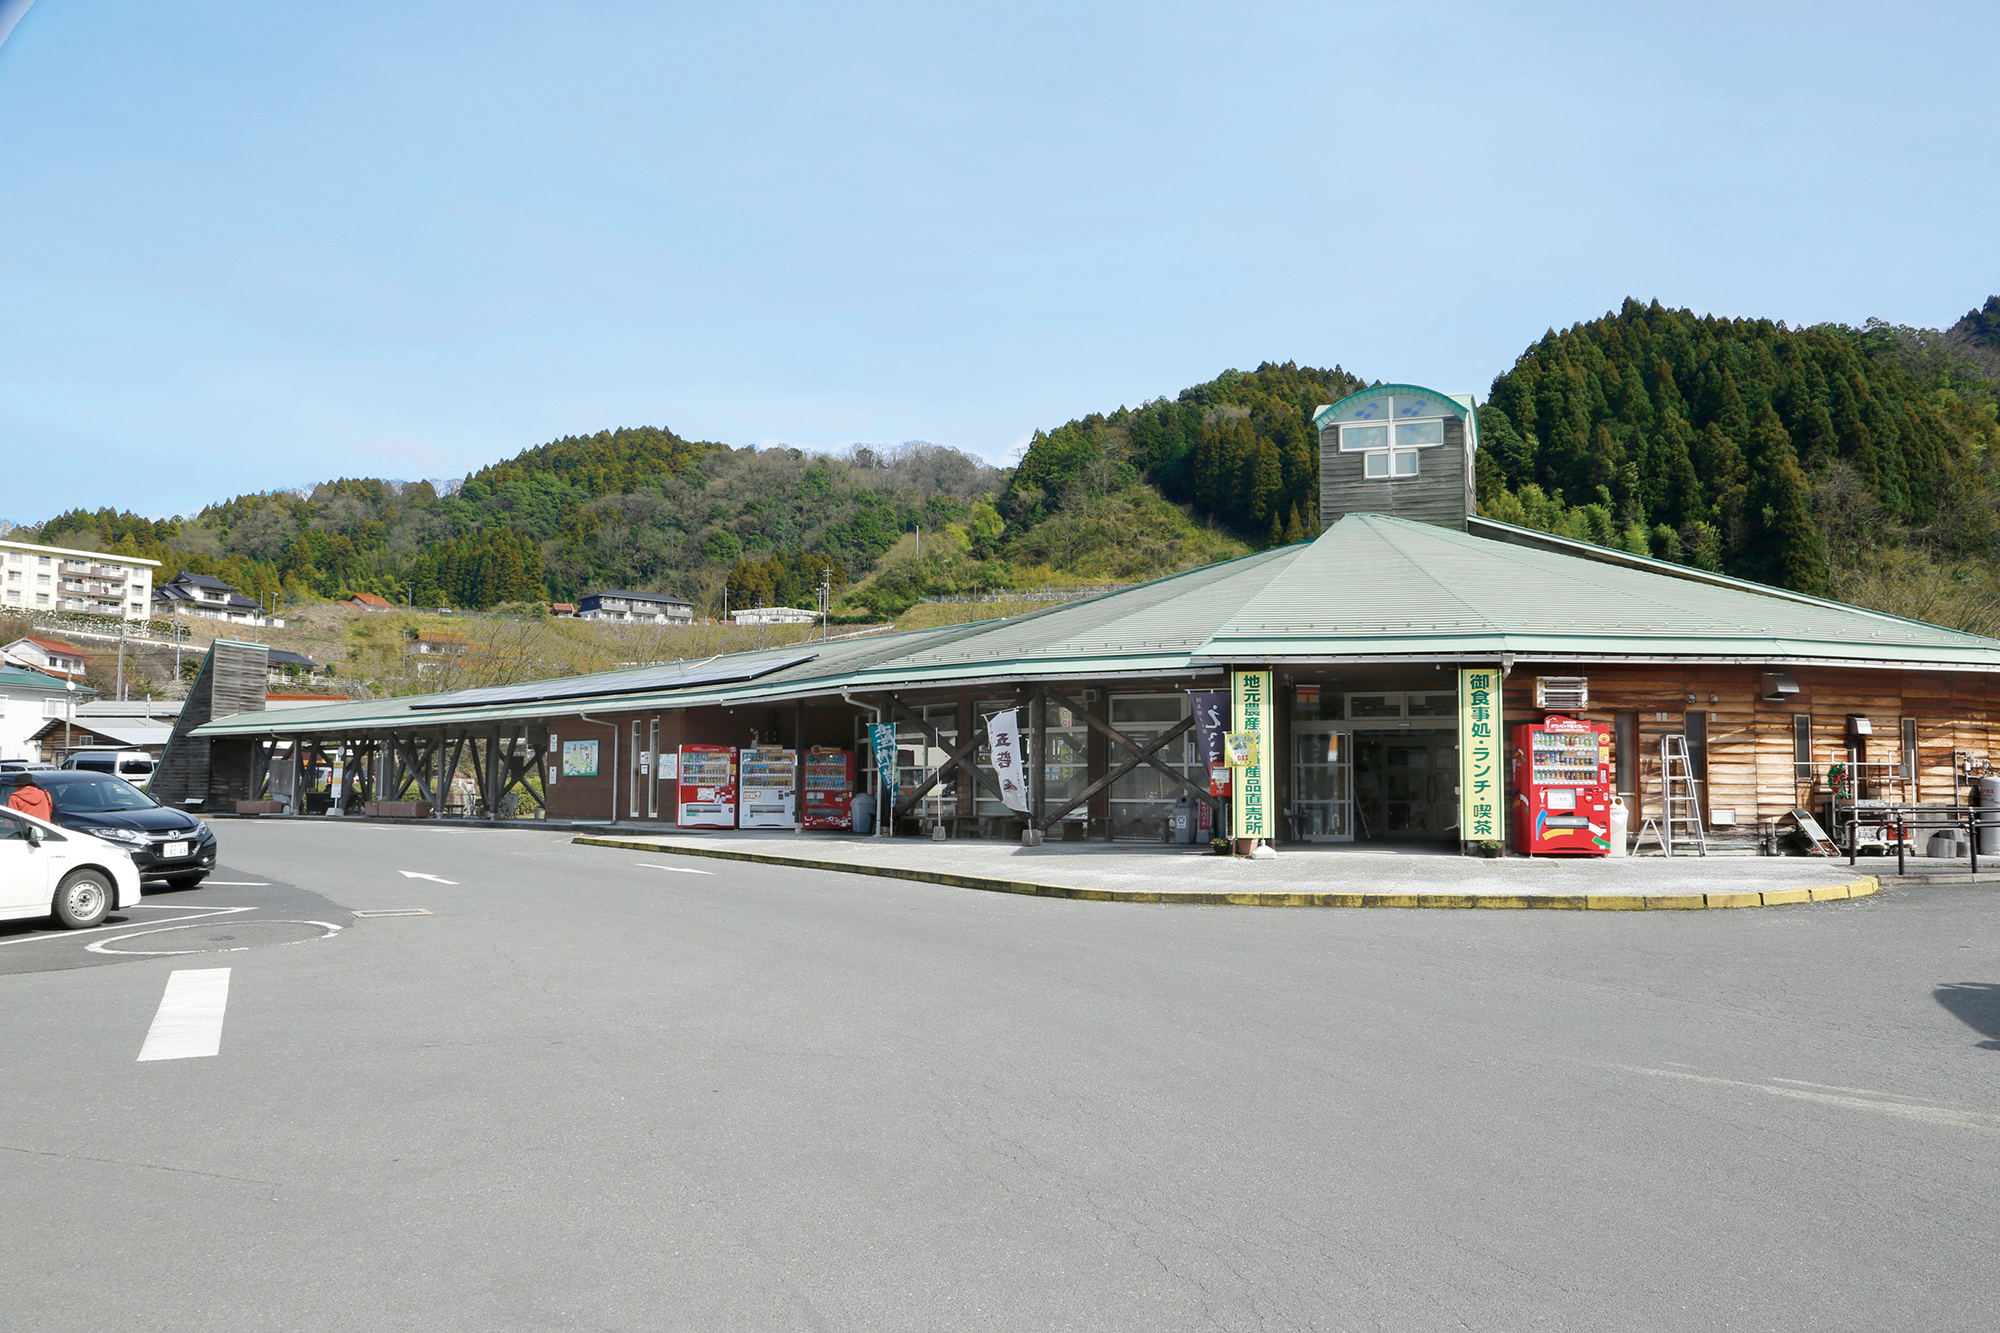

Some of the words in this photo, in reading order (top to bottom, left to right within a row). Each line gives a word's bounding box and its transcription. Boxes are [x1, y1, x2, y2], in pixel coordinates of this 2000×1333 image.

[1470, 673, 1492, 836] 御食事処・ランチ・喫茶
